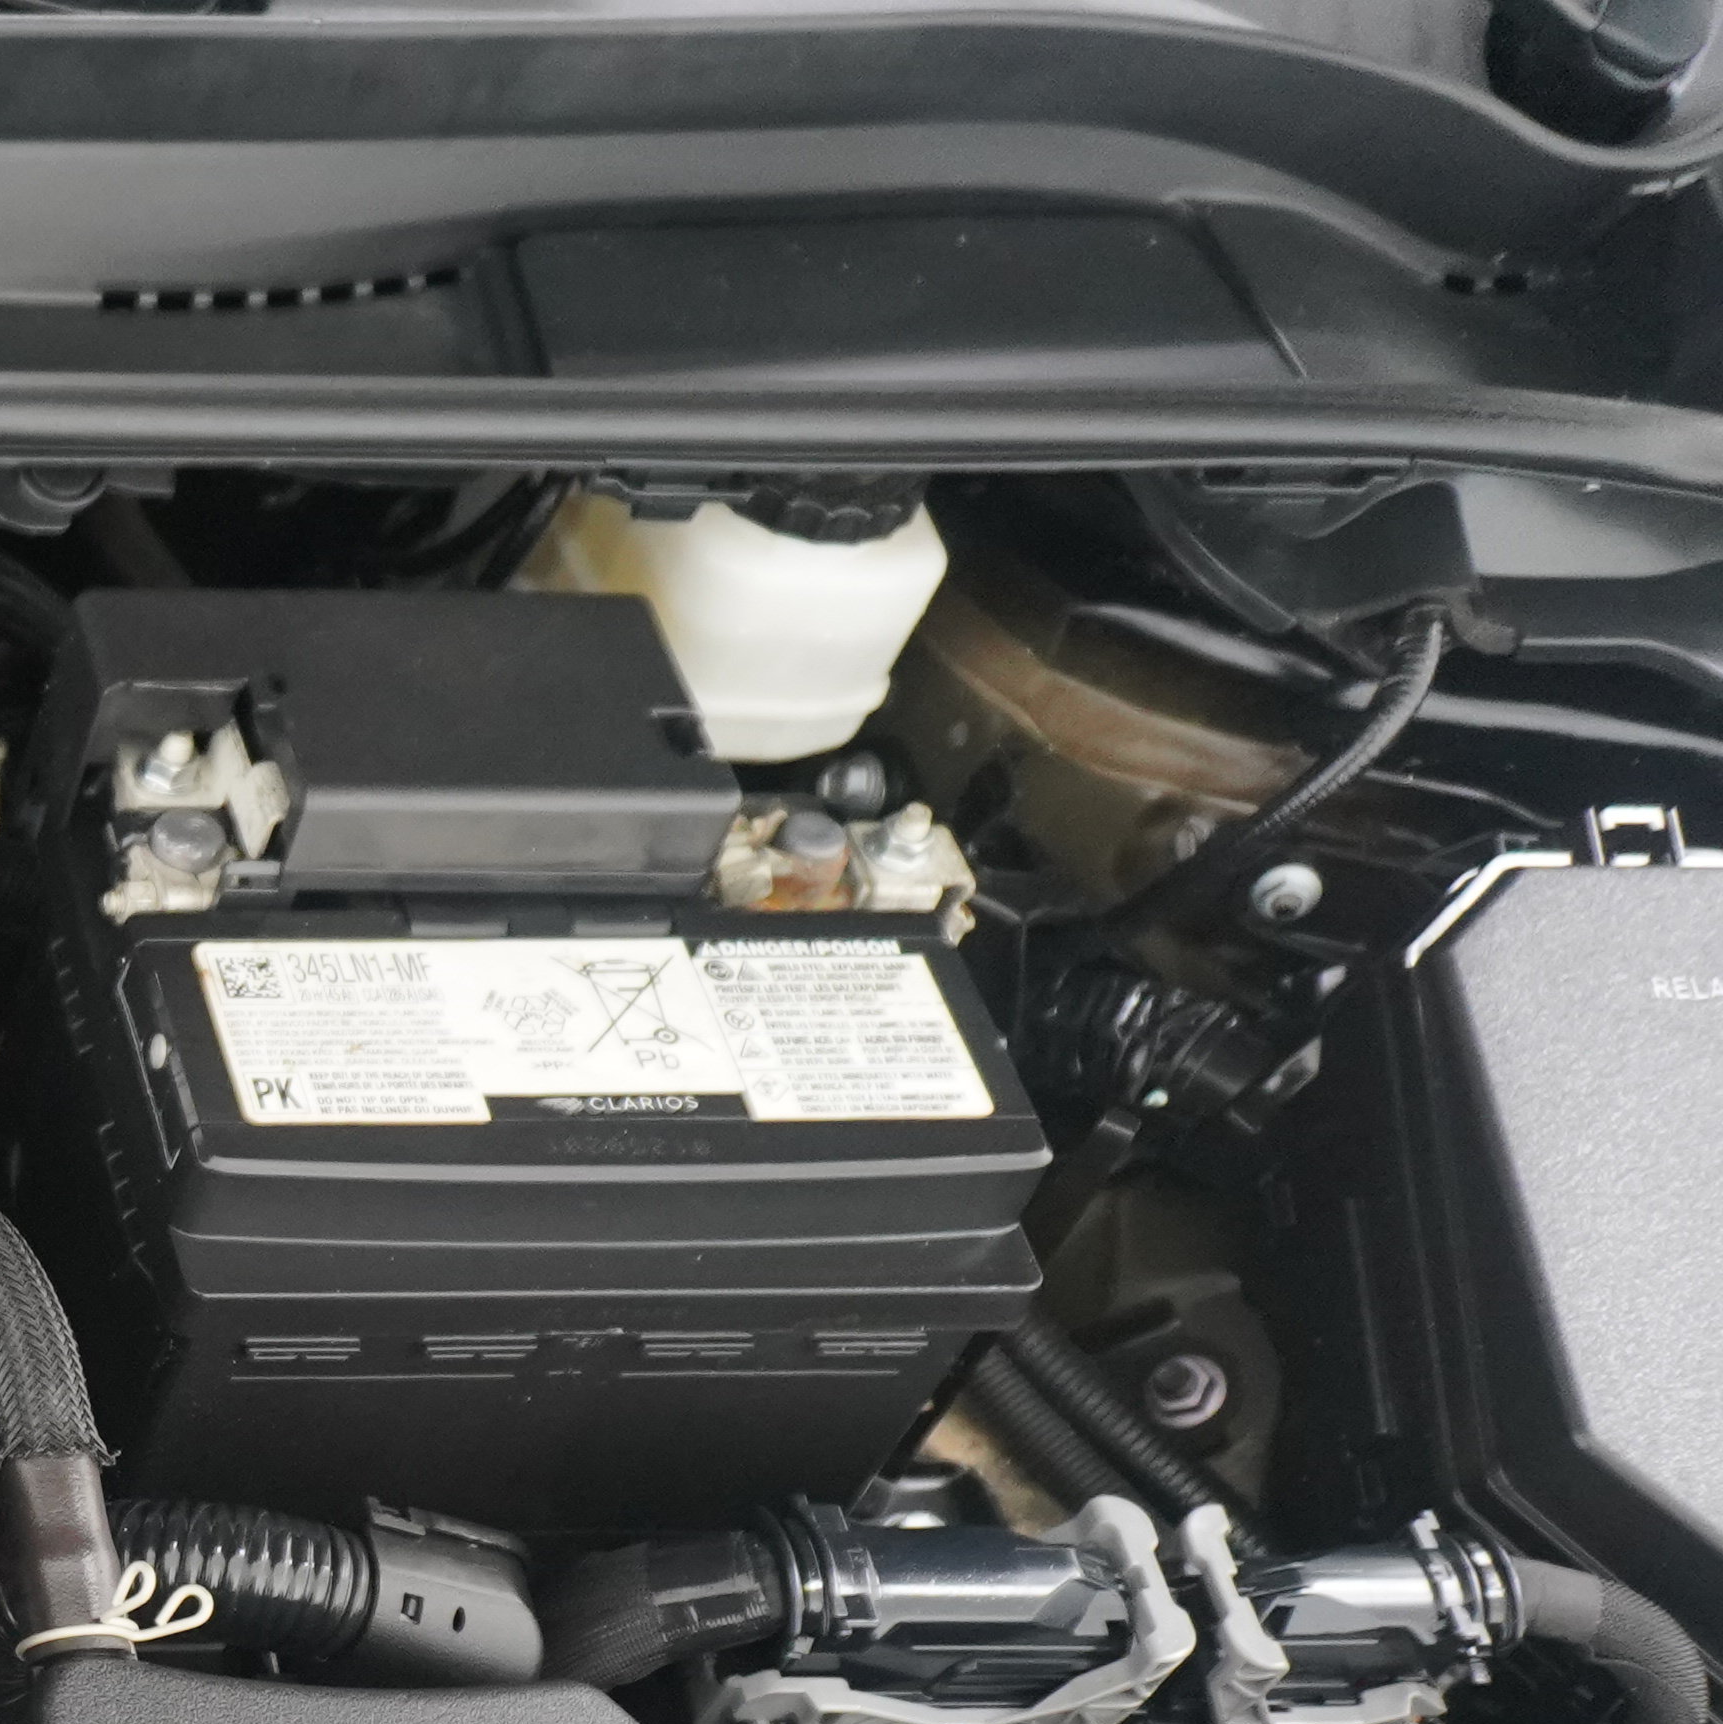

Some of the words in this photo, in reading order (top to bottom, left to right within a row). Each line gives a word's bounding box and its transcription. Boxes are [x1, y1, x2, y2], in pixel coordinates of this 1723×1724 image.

[719, 941, 900, 956] DANGER/POISON
[288, 952, 431, 983] 345LN1-MF
[635, 1050, 680, 1070] Pb
[252, 1077, 302, 1110] PK
[589, 1096, 700, 1111] CLARIOS
